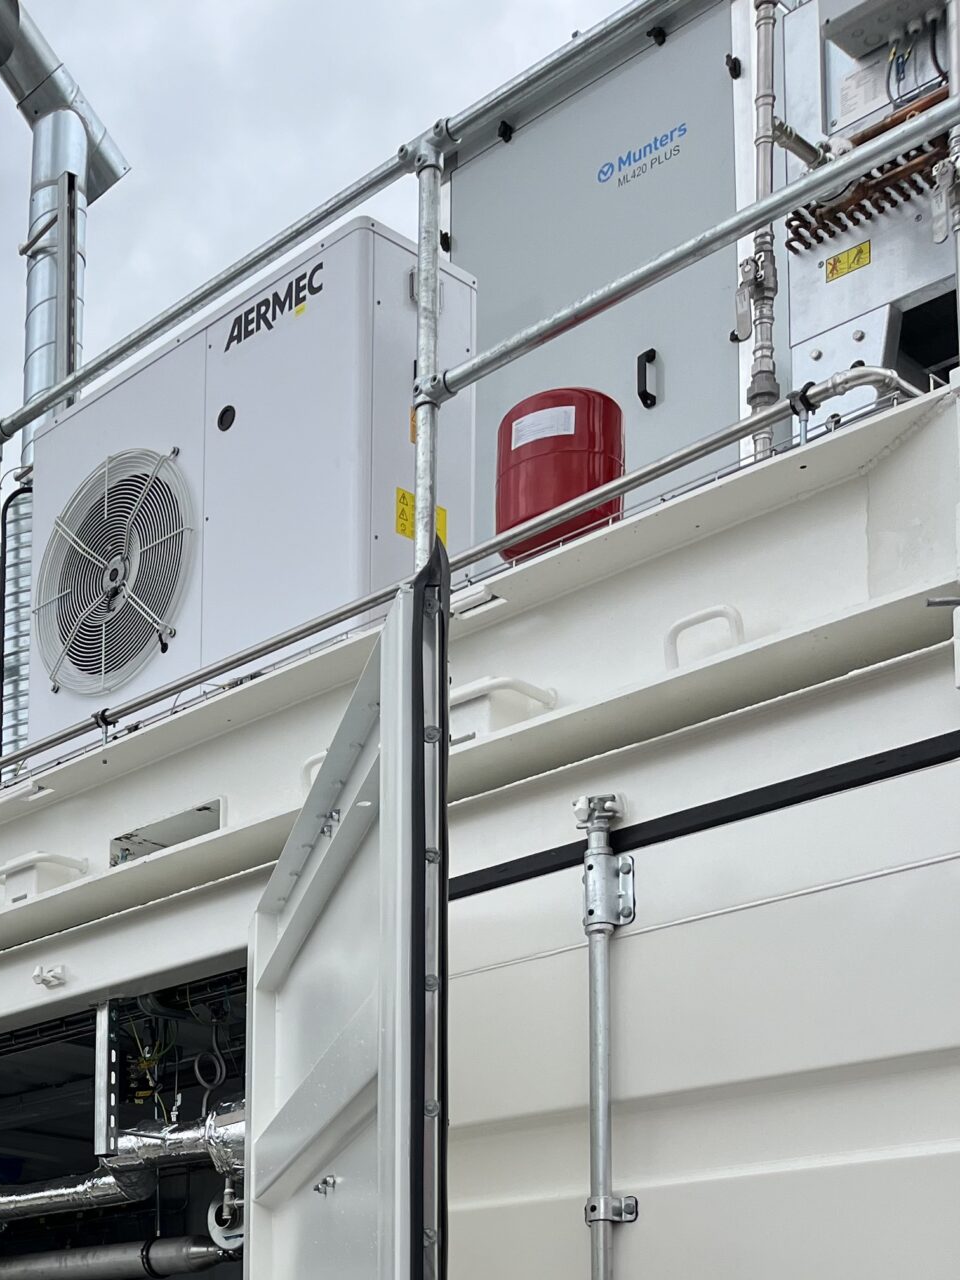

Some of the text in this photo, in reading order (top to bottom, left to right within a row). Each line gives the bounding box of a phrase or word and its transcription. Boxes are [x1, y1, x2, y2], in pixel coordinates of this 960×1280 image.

[617, 144, 681, 188] ML420 PLUS
[618, 122, 688, 172] Munters
[224, 261, 324, 353] AERMEC
